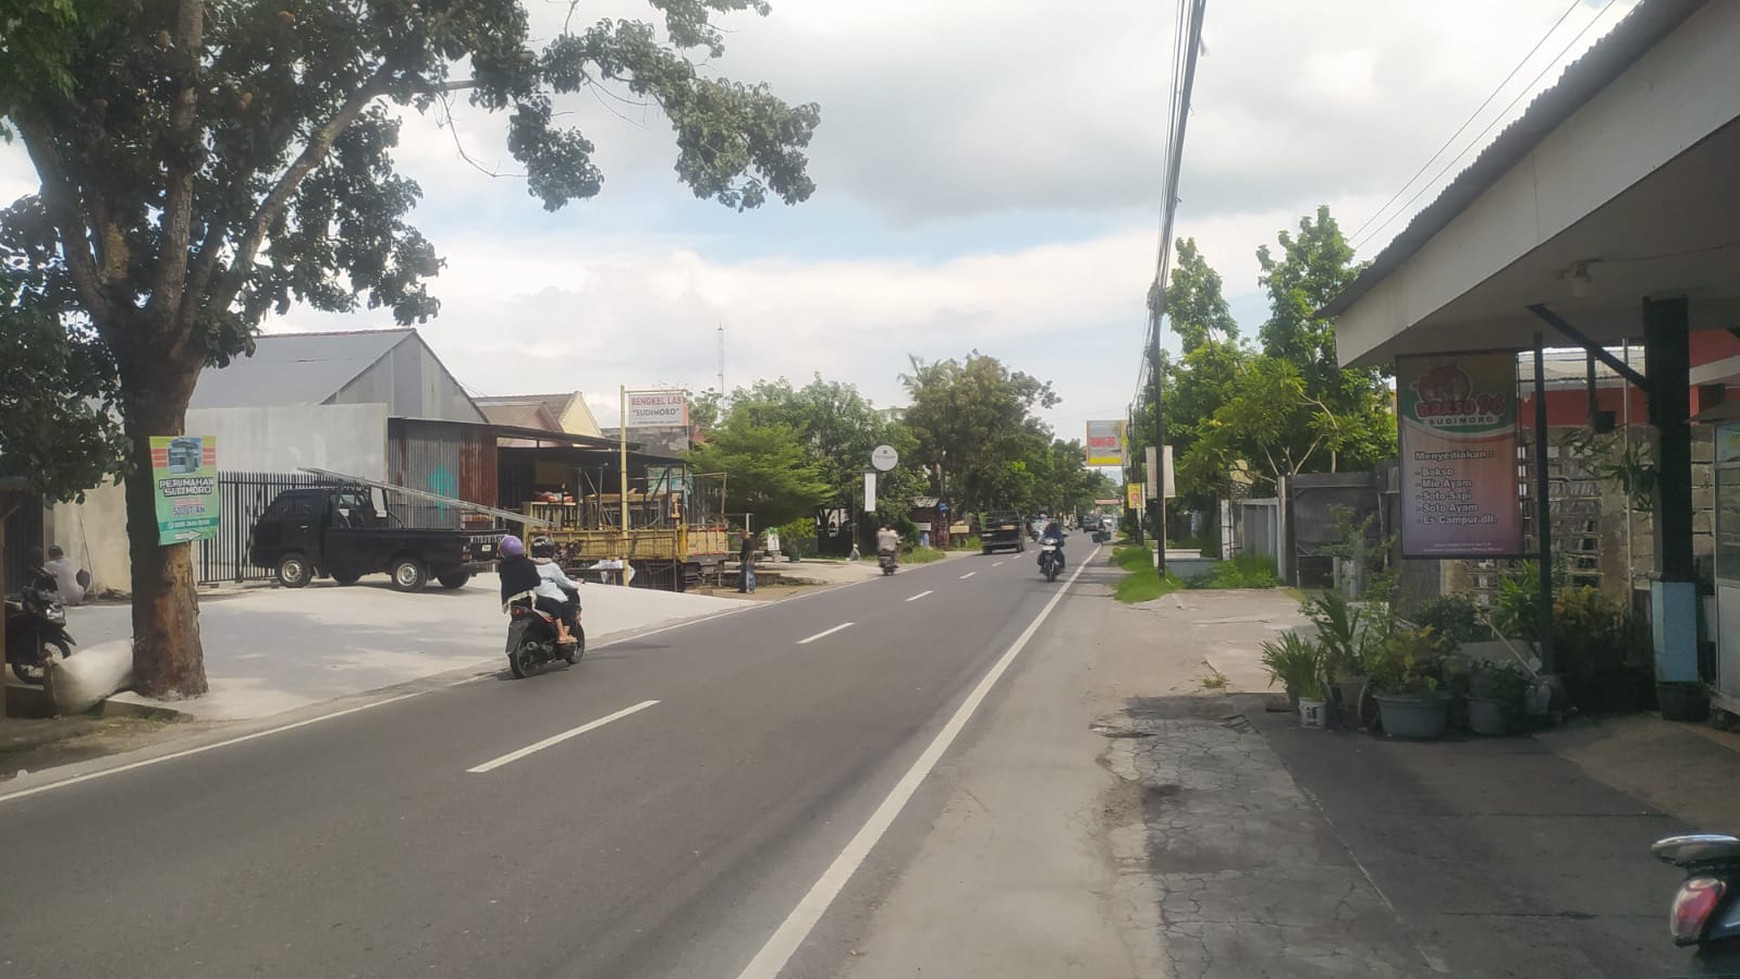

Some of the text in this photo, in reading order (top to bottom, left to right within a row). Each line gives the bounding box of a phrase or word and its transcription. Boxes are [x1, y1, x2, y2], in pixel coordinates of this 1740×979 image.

[668, 396, 681, 404] LAS
[1422, 467, 1454, 476] Bakso
[1422, 478, 1472, 490] Mie Ayam
[1422, 491, 1446, 501] Soto
[1423, 503, 1478, 513] Soto Ayam
[1423, 515, 1436, 524] Es
[1438, 514, 1478, 526] Campur
